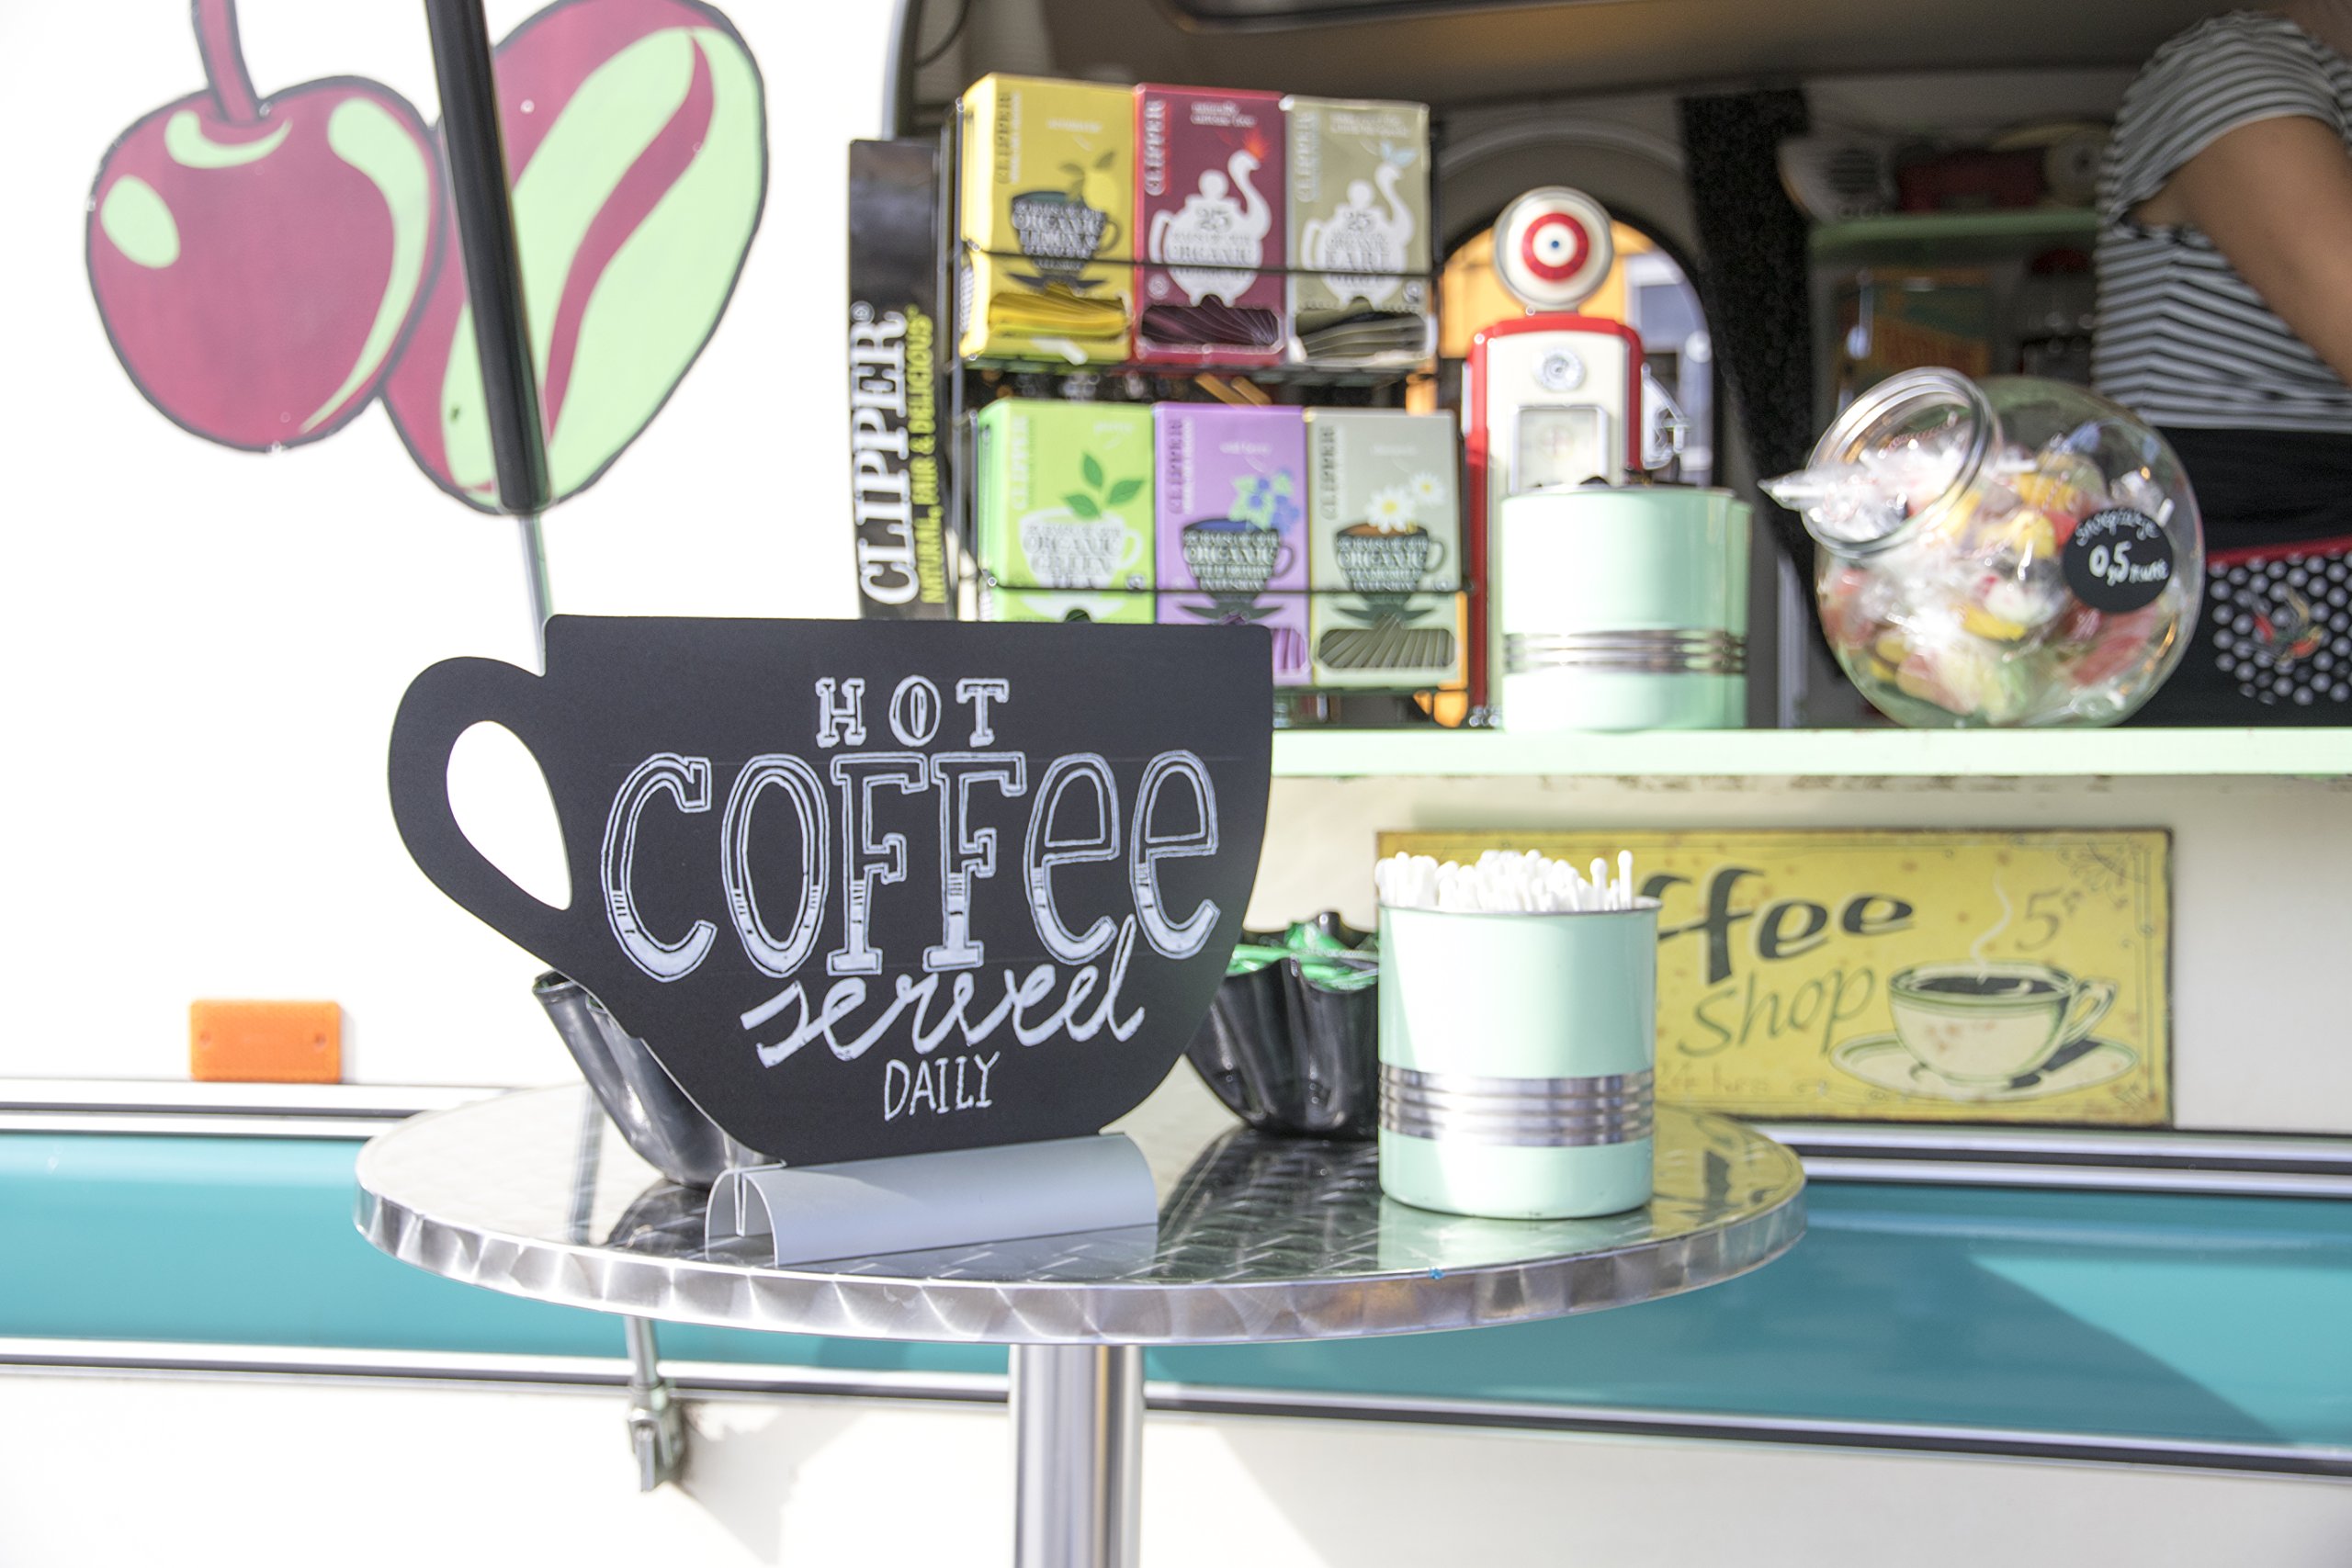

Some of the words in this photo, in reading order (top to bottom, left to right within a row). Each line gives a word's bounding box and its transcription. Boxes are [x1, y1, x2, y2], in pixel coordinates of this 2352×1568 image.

[849, 310, 920, 605] CLIPPER
[815, 674, 1010, 748] HOT
[740, 913, 1146, 1069] served
[884, 1051, 1000, 1121] DAILY
